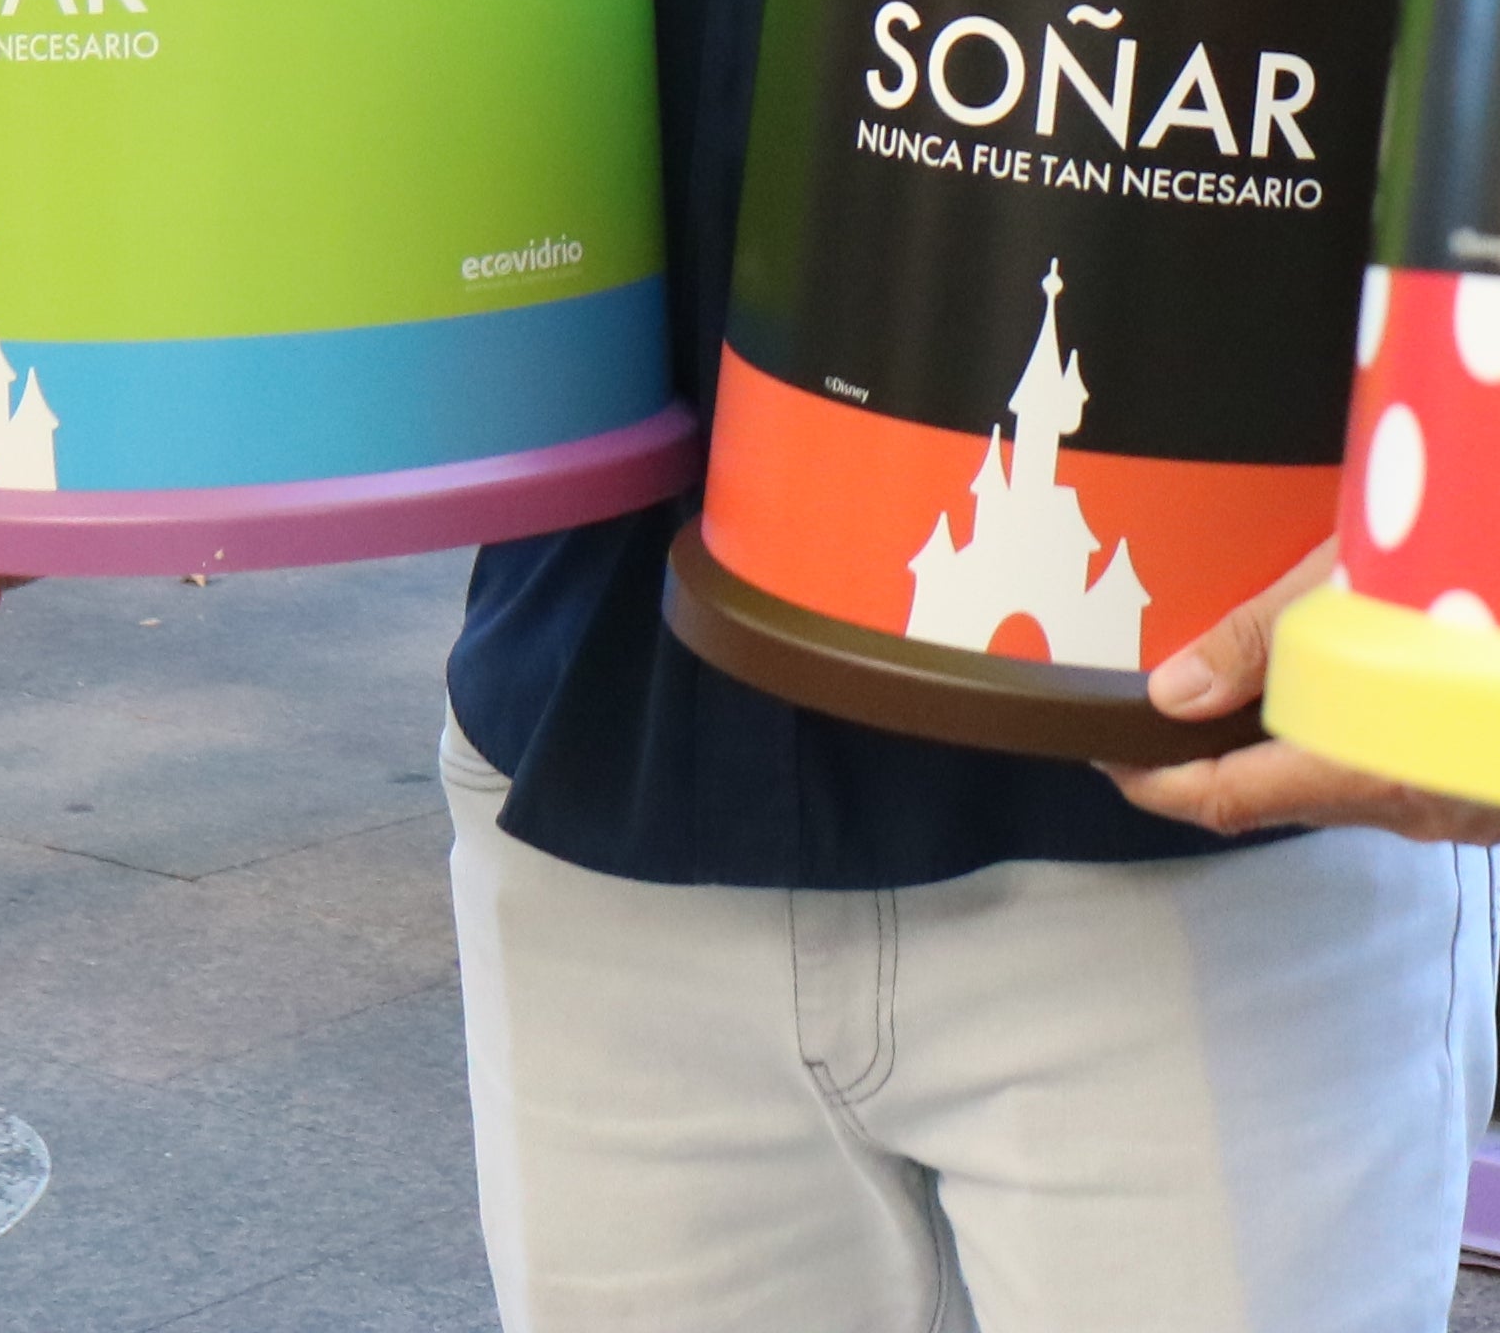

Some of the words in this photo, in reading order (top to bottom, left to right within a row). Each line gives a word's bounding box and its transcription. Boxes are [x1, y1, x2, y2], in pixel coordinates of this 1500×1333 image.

[866, 0, 1317, 160] SOÑAR
[856, 119, 963, 172] NUNCA
[972, 145, 1031, 184] FUE
[1041, 154, 1112, 194] TAN
[1122, 163, 1323, 210] NECESARIO
[461, 233, 583, 280] ecovidrio
